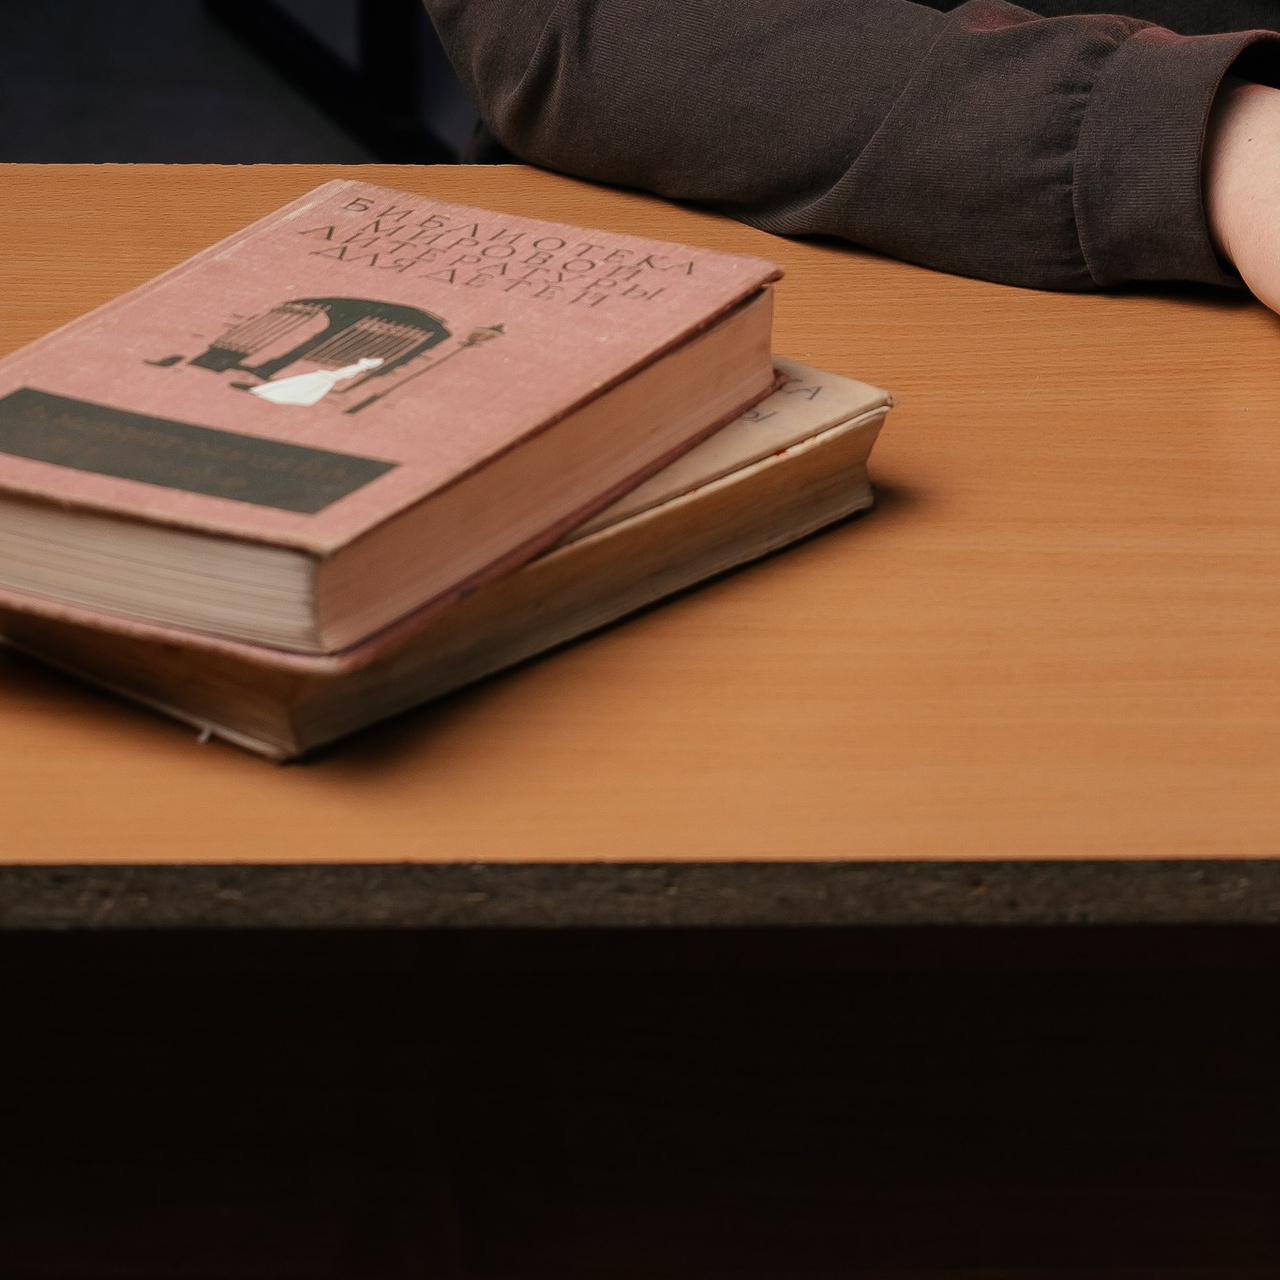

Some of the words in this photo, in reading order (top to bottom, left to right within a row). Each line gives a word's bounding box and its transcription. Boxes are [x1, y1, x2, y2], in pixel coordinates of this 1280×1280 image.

[298, 224, 667, 302] ЛИТЕРАТУРЫ
[341, 196, 696, 276] БИБЛИОТЕКА
[359, 219, 643, 283] МИРОВОЙ
[309, 245, 421, 274] ДЛЯ
[418, 267, 612, 307] ДЕТЕЙ
